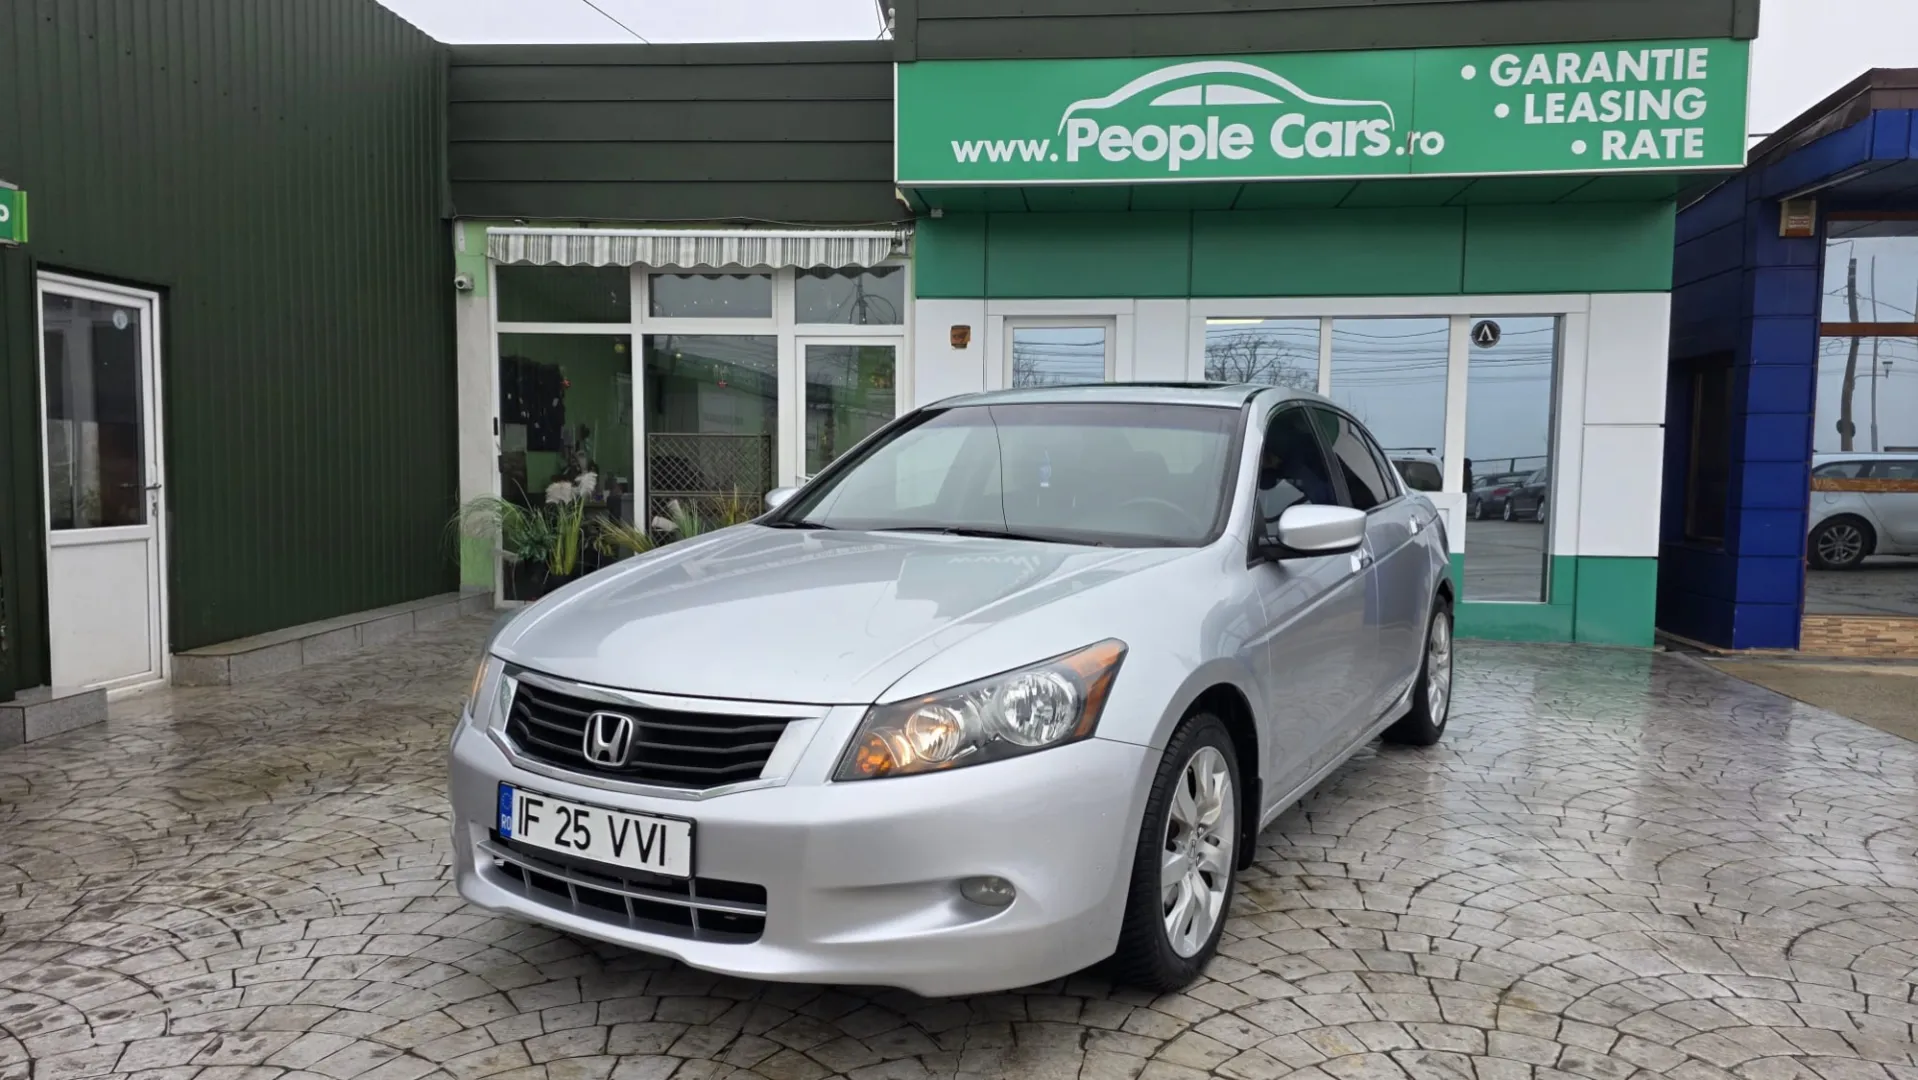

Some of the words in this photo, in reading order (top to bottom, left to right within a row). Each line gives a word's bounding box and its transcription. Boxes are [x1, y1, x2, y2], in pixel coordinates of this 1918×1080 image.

[1490, 48, 1709, 87] GARANTIE
[1524, 87, 1707, 124] LEASING
[1602, 128, 1704, 160] RATE
[501, 813, 512, 830] RO
[518, 796, 543, 836] IF
[555, 806, 591, 850] 25
[607, 815, 667, 867] VVI
